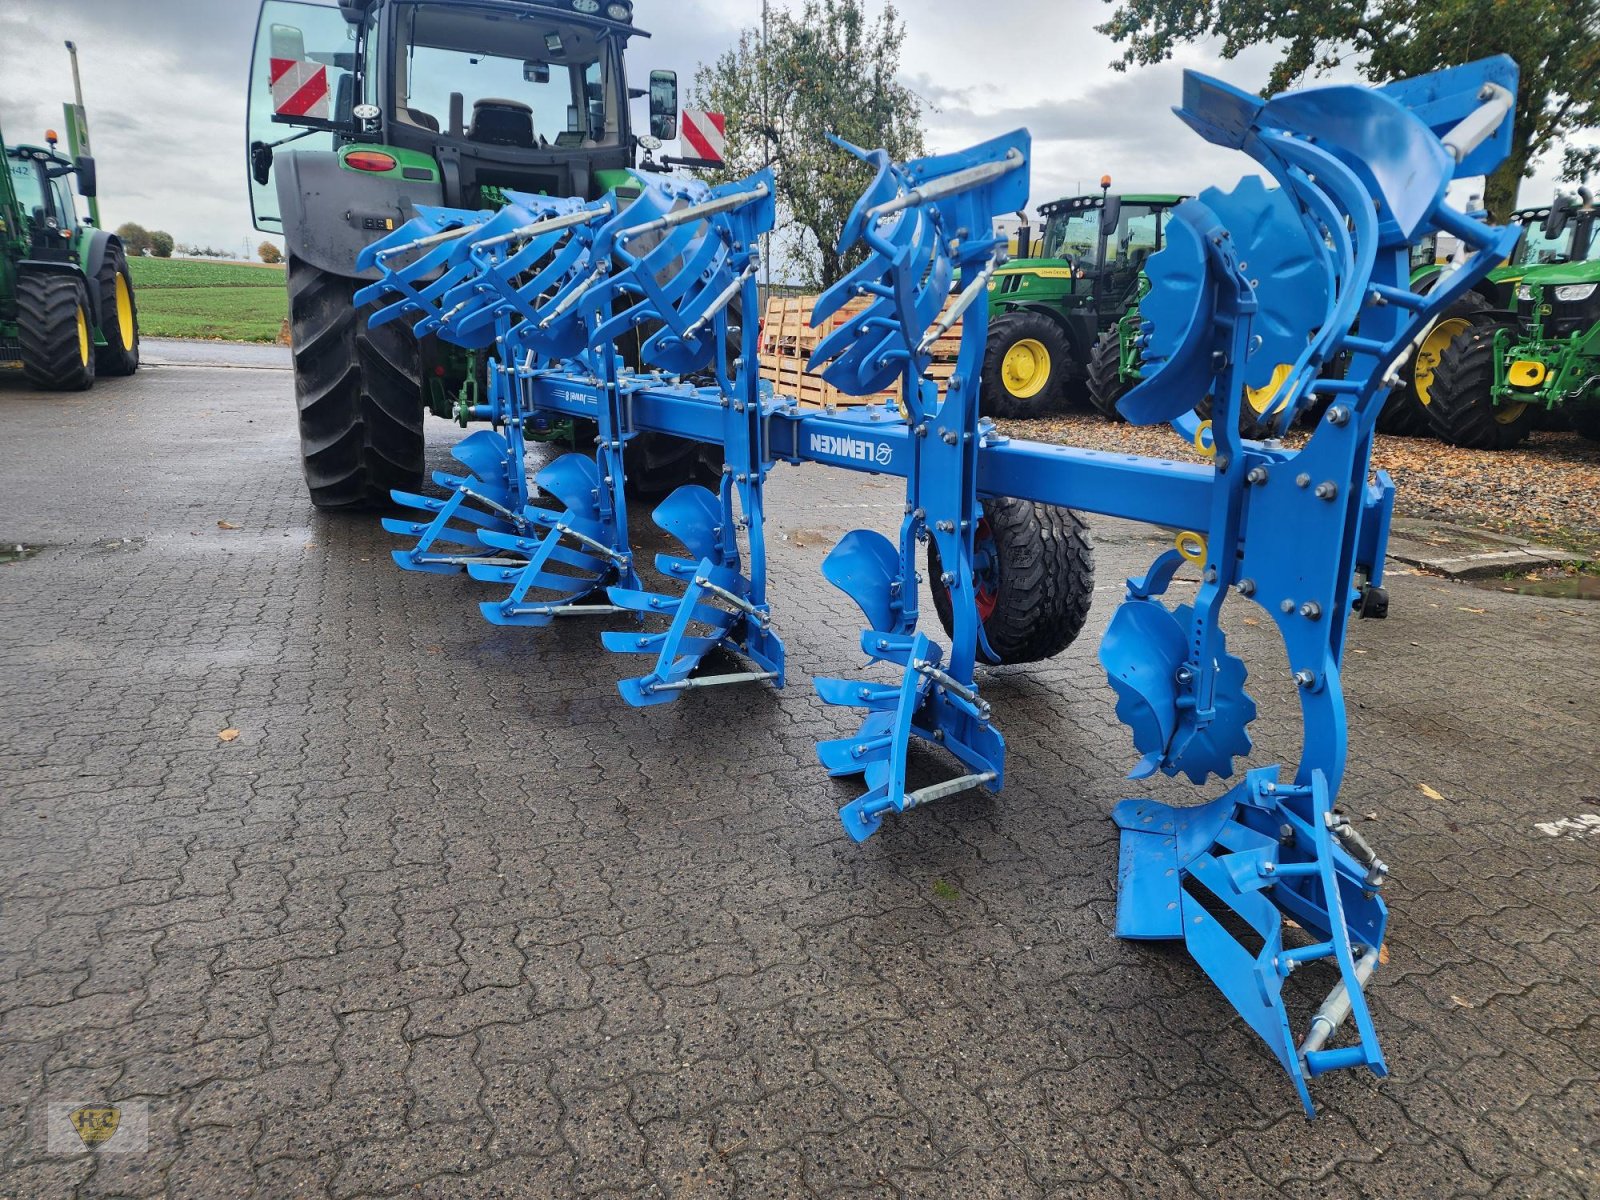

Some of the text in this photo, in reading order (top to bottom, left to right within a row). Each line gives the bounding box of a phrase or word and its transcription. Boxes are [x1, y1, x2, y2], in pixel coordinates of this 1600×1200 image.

[565, 391, 587, 405] Juwel 8
[810, 433, 874, 462] LEMKEN
